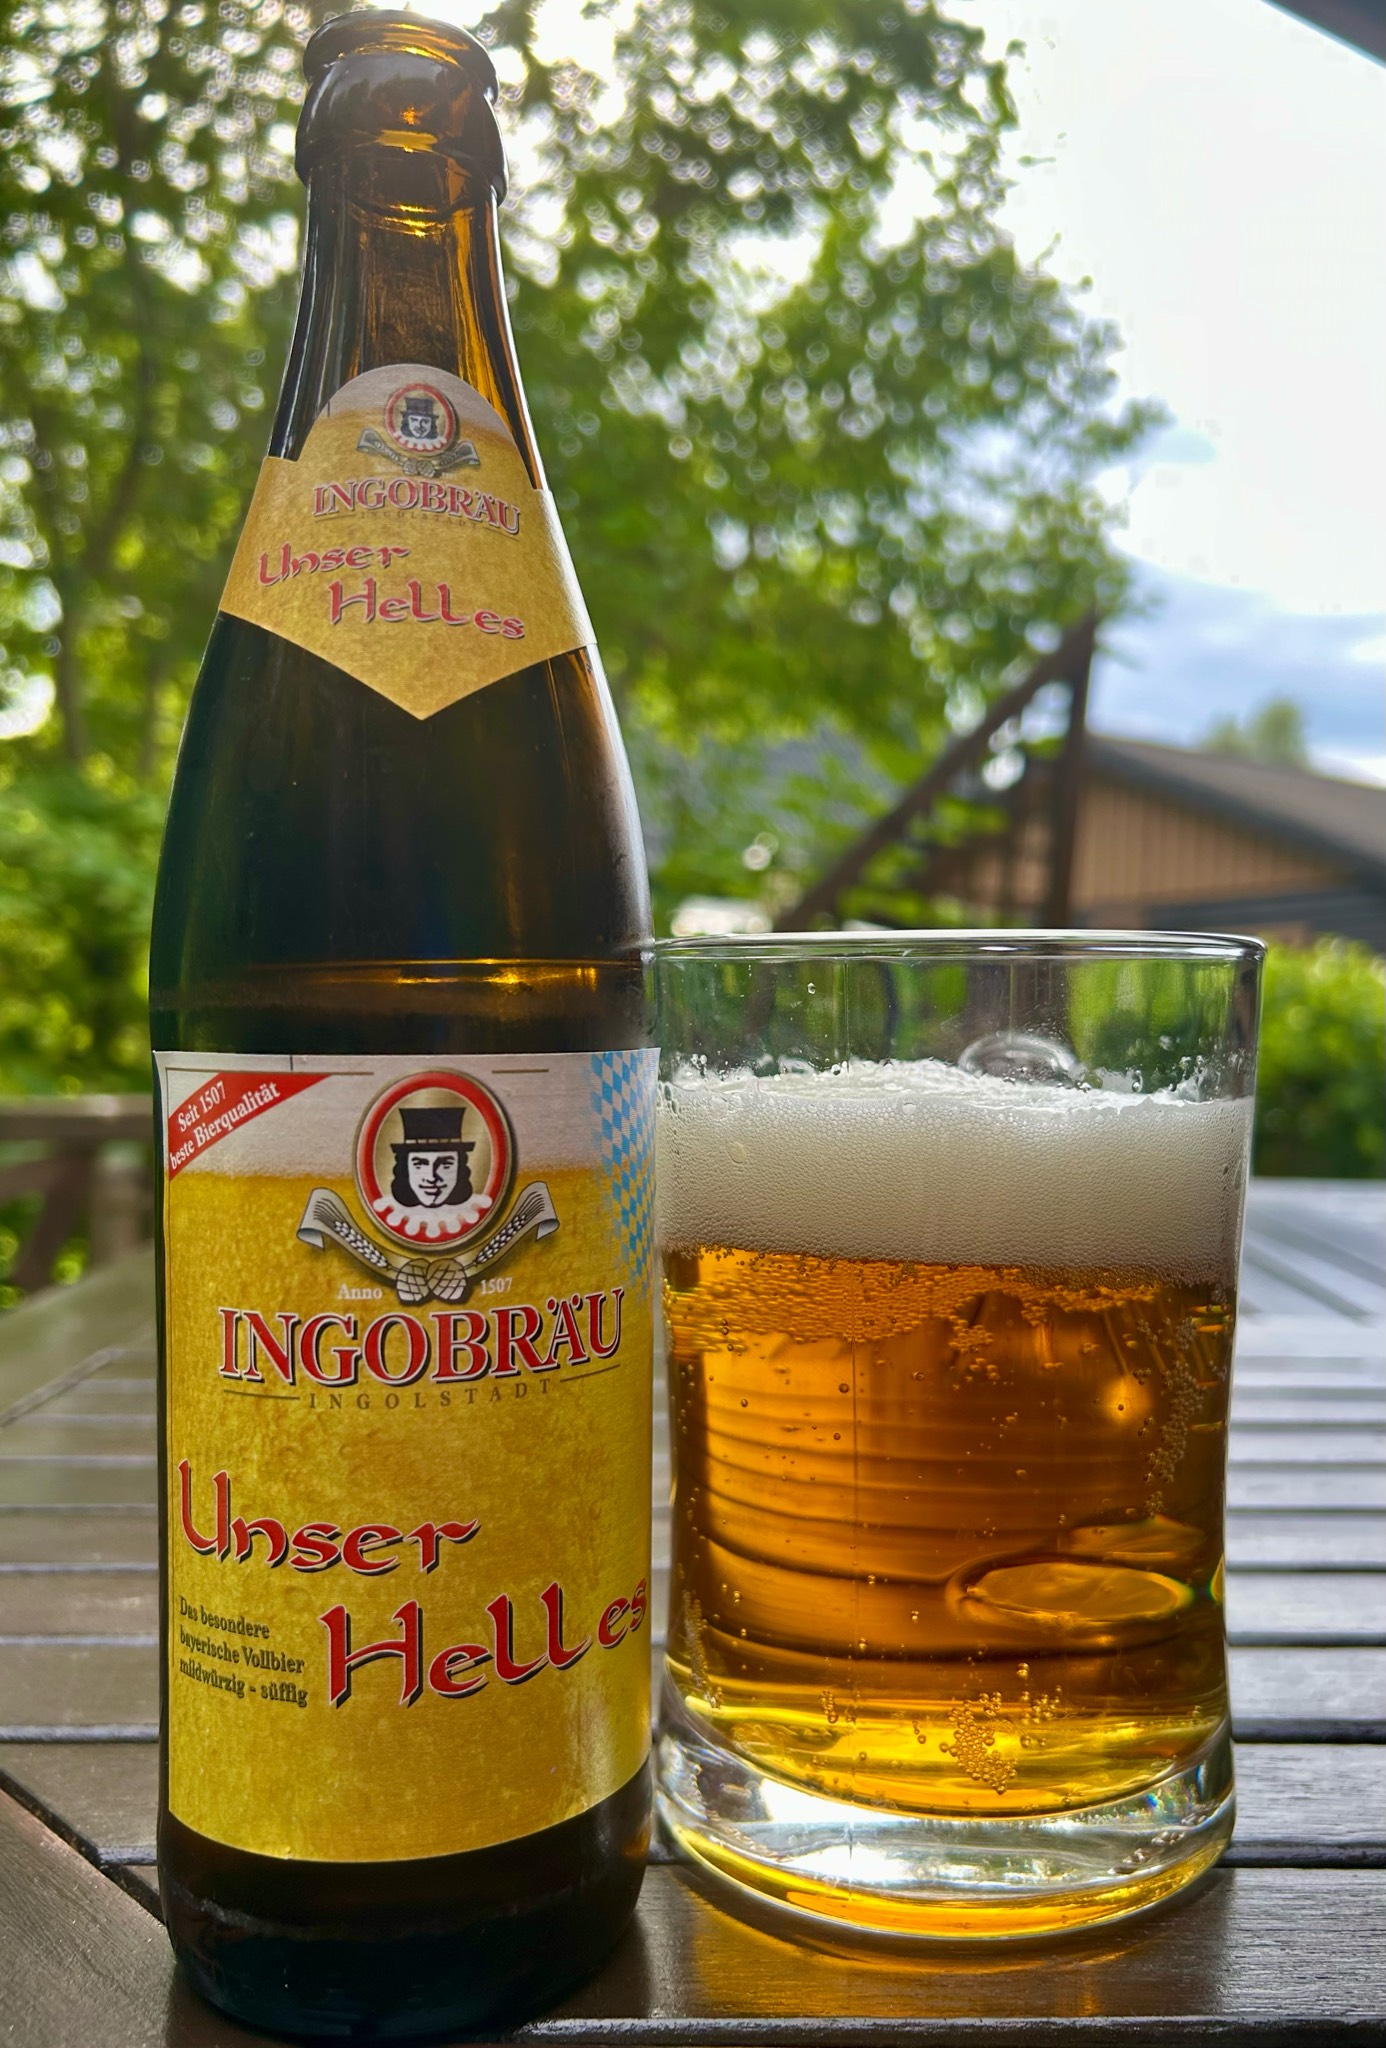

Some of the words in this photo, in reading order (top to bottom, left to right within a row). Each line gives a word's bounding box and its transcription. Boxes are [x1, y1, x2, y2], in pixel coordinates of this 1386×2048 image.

[313, 478, 520, 535] INGOBRÄU
[258, 543, 409, 585] Unser
[327, 577, 526, 639] Helles
[169, 1139, 195, 1170] beste
[193, 1081, 281, 1148] Bierqualität
[177, 1104, 201, 1132] Seit
[199, 1080, 227, 1114] 1507
[337, 1283, 383, 1300] Anno
[479, 1276, 514, 1296] 1507
[218, 1287, 625, 1388] INGOBRÄU
[308, 1378, 550, 1410] INGOLSTADT
[178, 1459, 480, 1574] Unser
[179, 1595, 199, 1622] Das
[200, 1604, 271, 1640] besondere
[319, 1577, 647, 1708] Helles
[179, 1624, 240, 1664] bayerische
[241, 1645, 306, 1674] Vollbier
[179, 1658, 246, 1699] mildwürzig
[260, 1682, 309, 1708] süffig
